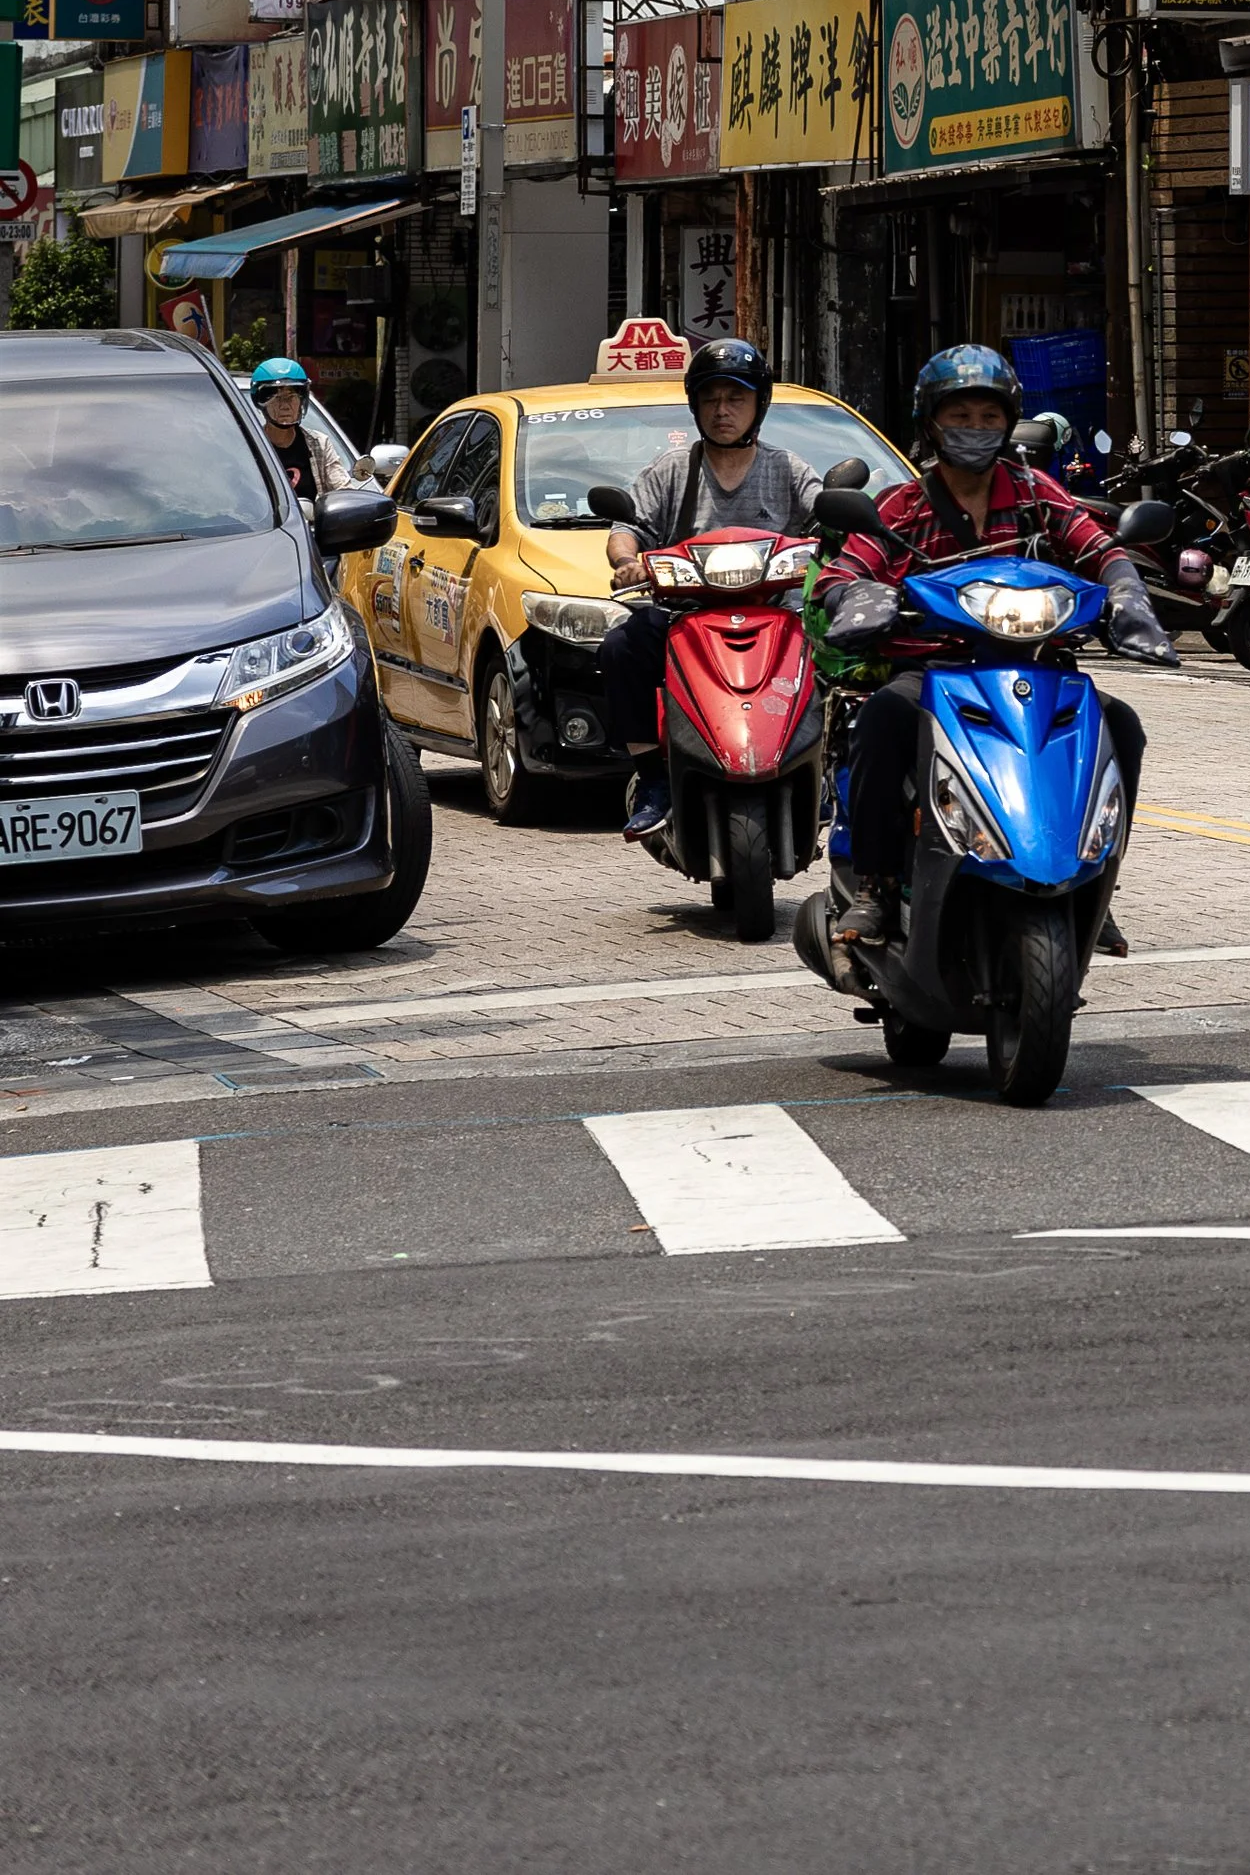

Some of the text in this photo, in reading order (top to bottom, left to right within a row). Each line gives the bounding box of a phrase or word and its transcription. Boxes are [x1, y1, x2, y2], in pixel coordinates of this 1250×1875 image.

[77, 12, 122, 25] 台灣彩券
[506, 51, 568, 110] 進口百貨
[728, 11, 870, 140] 麒麟牌洋傘
[689, 232, 737, 332] 興美
[628, 325, 658, 346] M
[607, 349, 687, 372] 大都會
[527, 408, 605, 424] 55766
